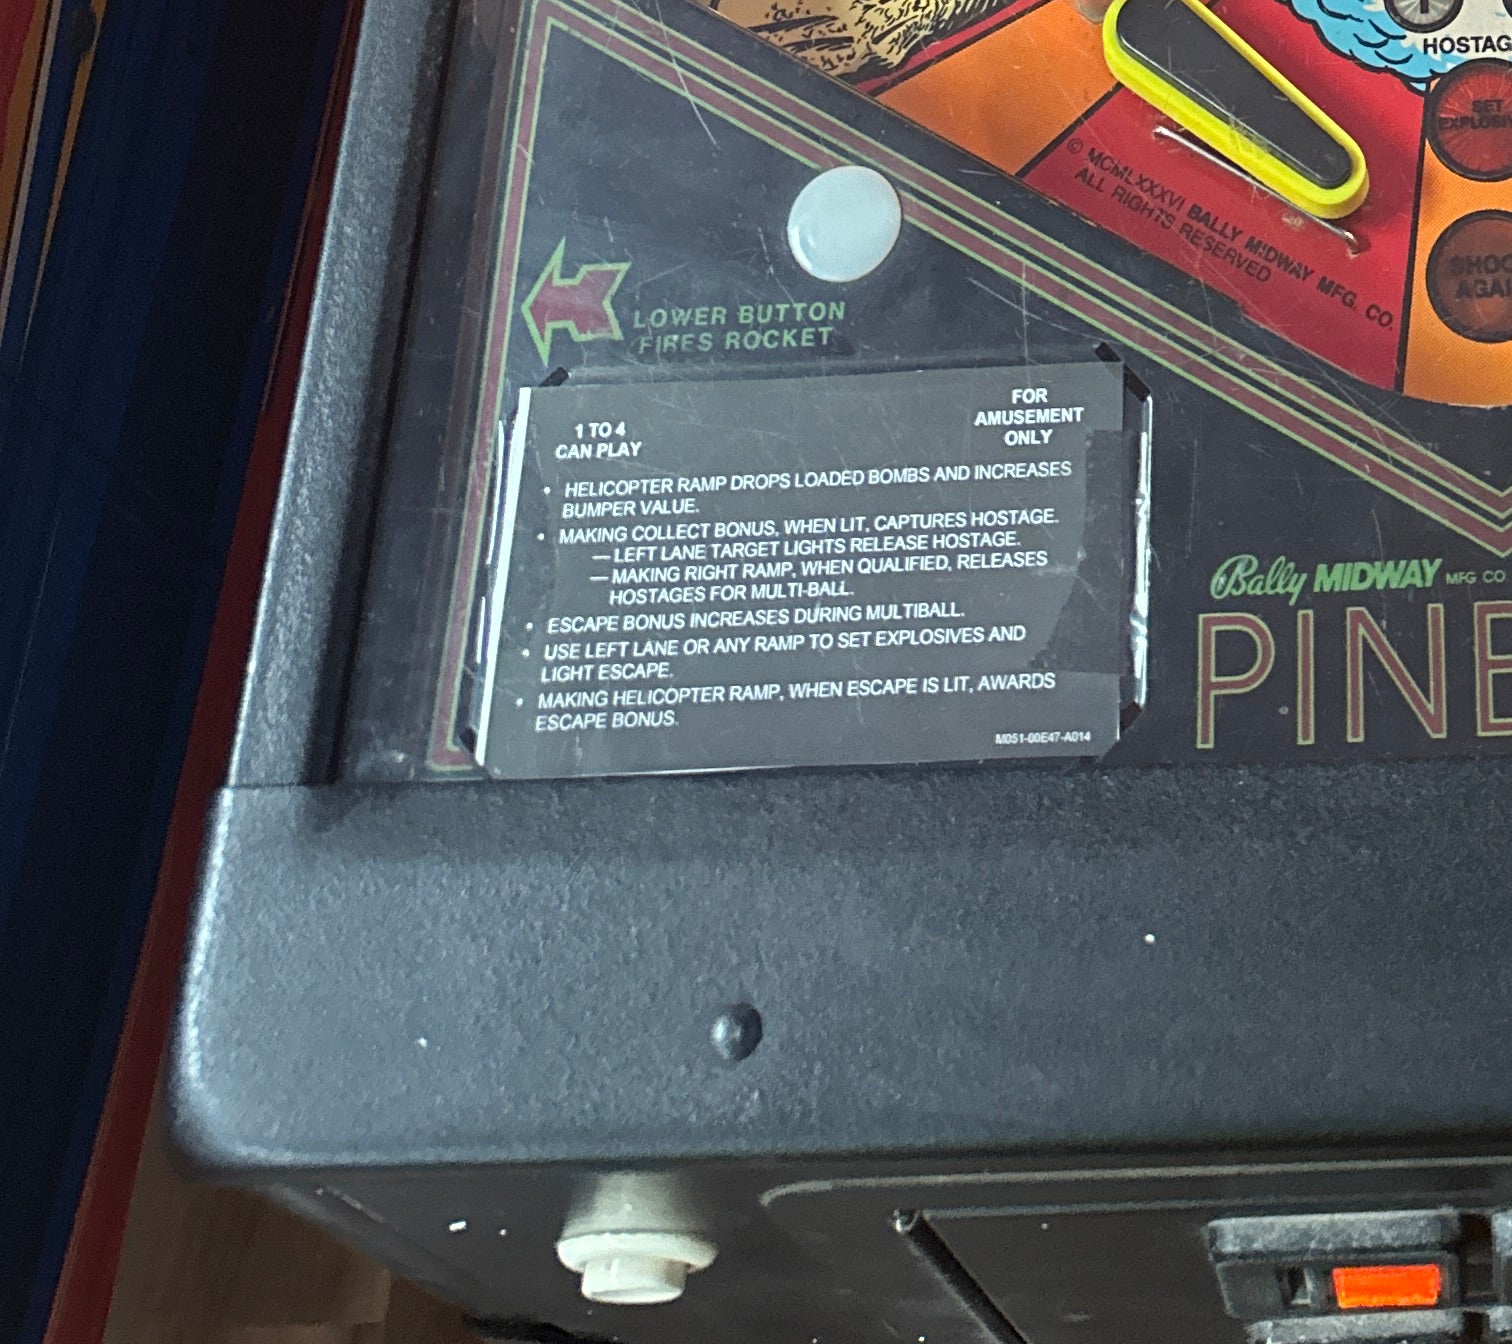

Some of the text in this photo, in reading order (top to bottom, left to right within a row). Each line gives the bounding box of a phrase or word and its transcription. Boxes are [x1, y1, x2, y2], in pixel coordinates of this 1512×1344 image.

[1074, 166, 1272, 284] ALL RIGHTS RESERVED
[1188, 203, 1242, 243] BALLY
[1246, 236, 1315, 283] MIDWAY
[1316, 276, 1359, 310] MFG.
[1365, 303, 1395, 331] CO.
[633, 301, 846, 330] LOWER BUTTON
[638, 326, 834, 353] FIRES ROCKET
[1011, 388, 1048, 404] FOR
[974, 407, 1084, 427] AMUSEMENT
[555, 441, 642, 459] CAN PLAY
[1004, 429, 1053, 446] ONLY
[564, 461, 1073, 498] HELICOPTER RAMP DROPS LOADED BOMBS AND INCREASES
[562, 497, 700, 519] BUMPER VALUE.
[559, 509, 1060, 545] MAKING COLLECT WHEN CAPTURES HOSTAGE.
[660, 531, 1021, 561] LANE TARGET LIGHTS RELEASE HOSTAGE.
[683, 551, 1048, 581] RIGHT WHEN RELEASES
[1210, 554, 1443, 606] Bally MIDWAY
[609, 584, 746, 606] HOSTAGES FOR
[547, 602, 966, 635] ESCAPE BONUS INCREASES DURING MULTIBALL.
[544, 625, 1027, 661] USE LEFT LANE OR ANY RAMP TO SET EXPLOSIVES AND
[541, 662, 674, 683] LIGHT ESCAPE.
[537, 672, 1056, 710] MAKING HELICOPTER WHEN ESCAPE AWARDS
[535, 710, 679, 732] ESCAPE BONUS.
